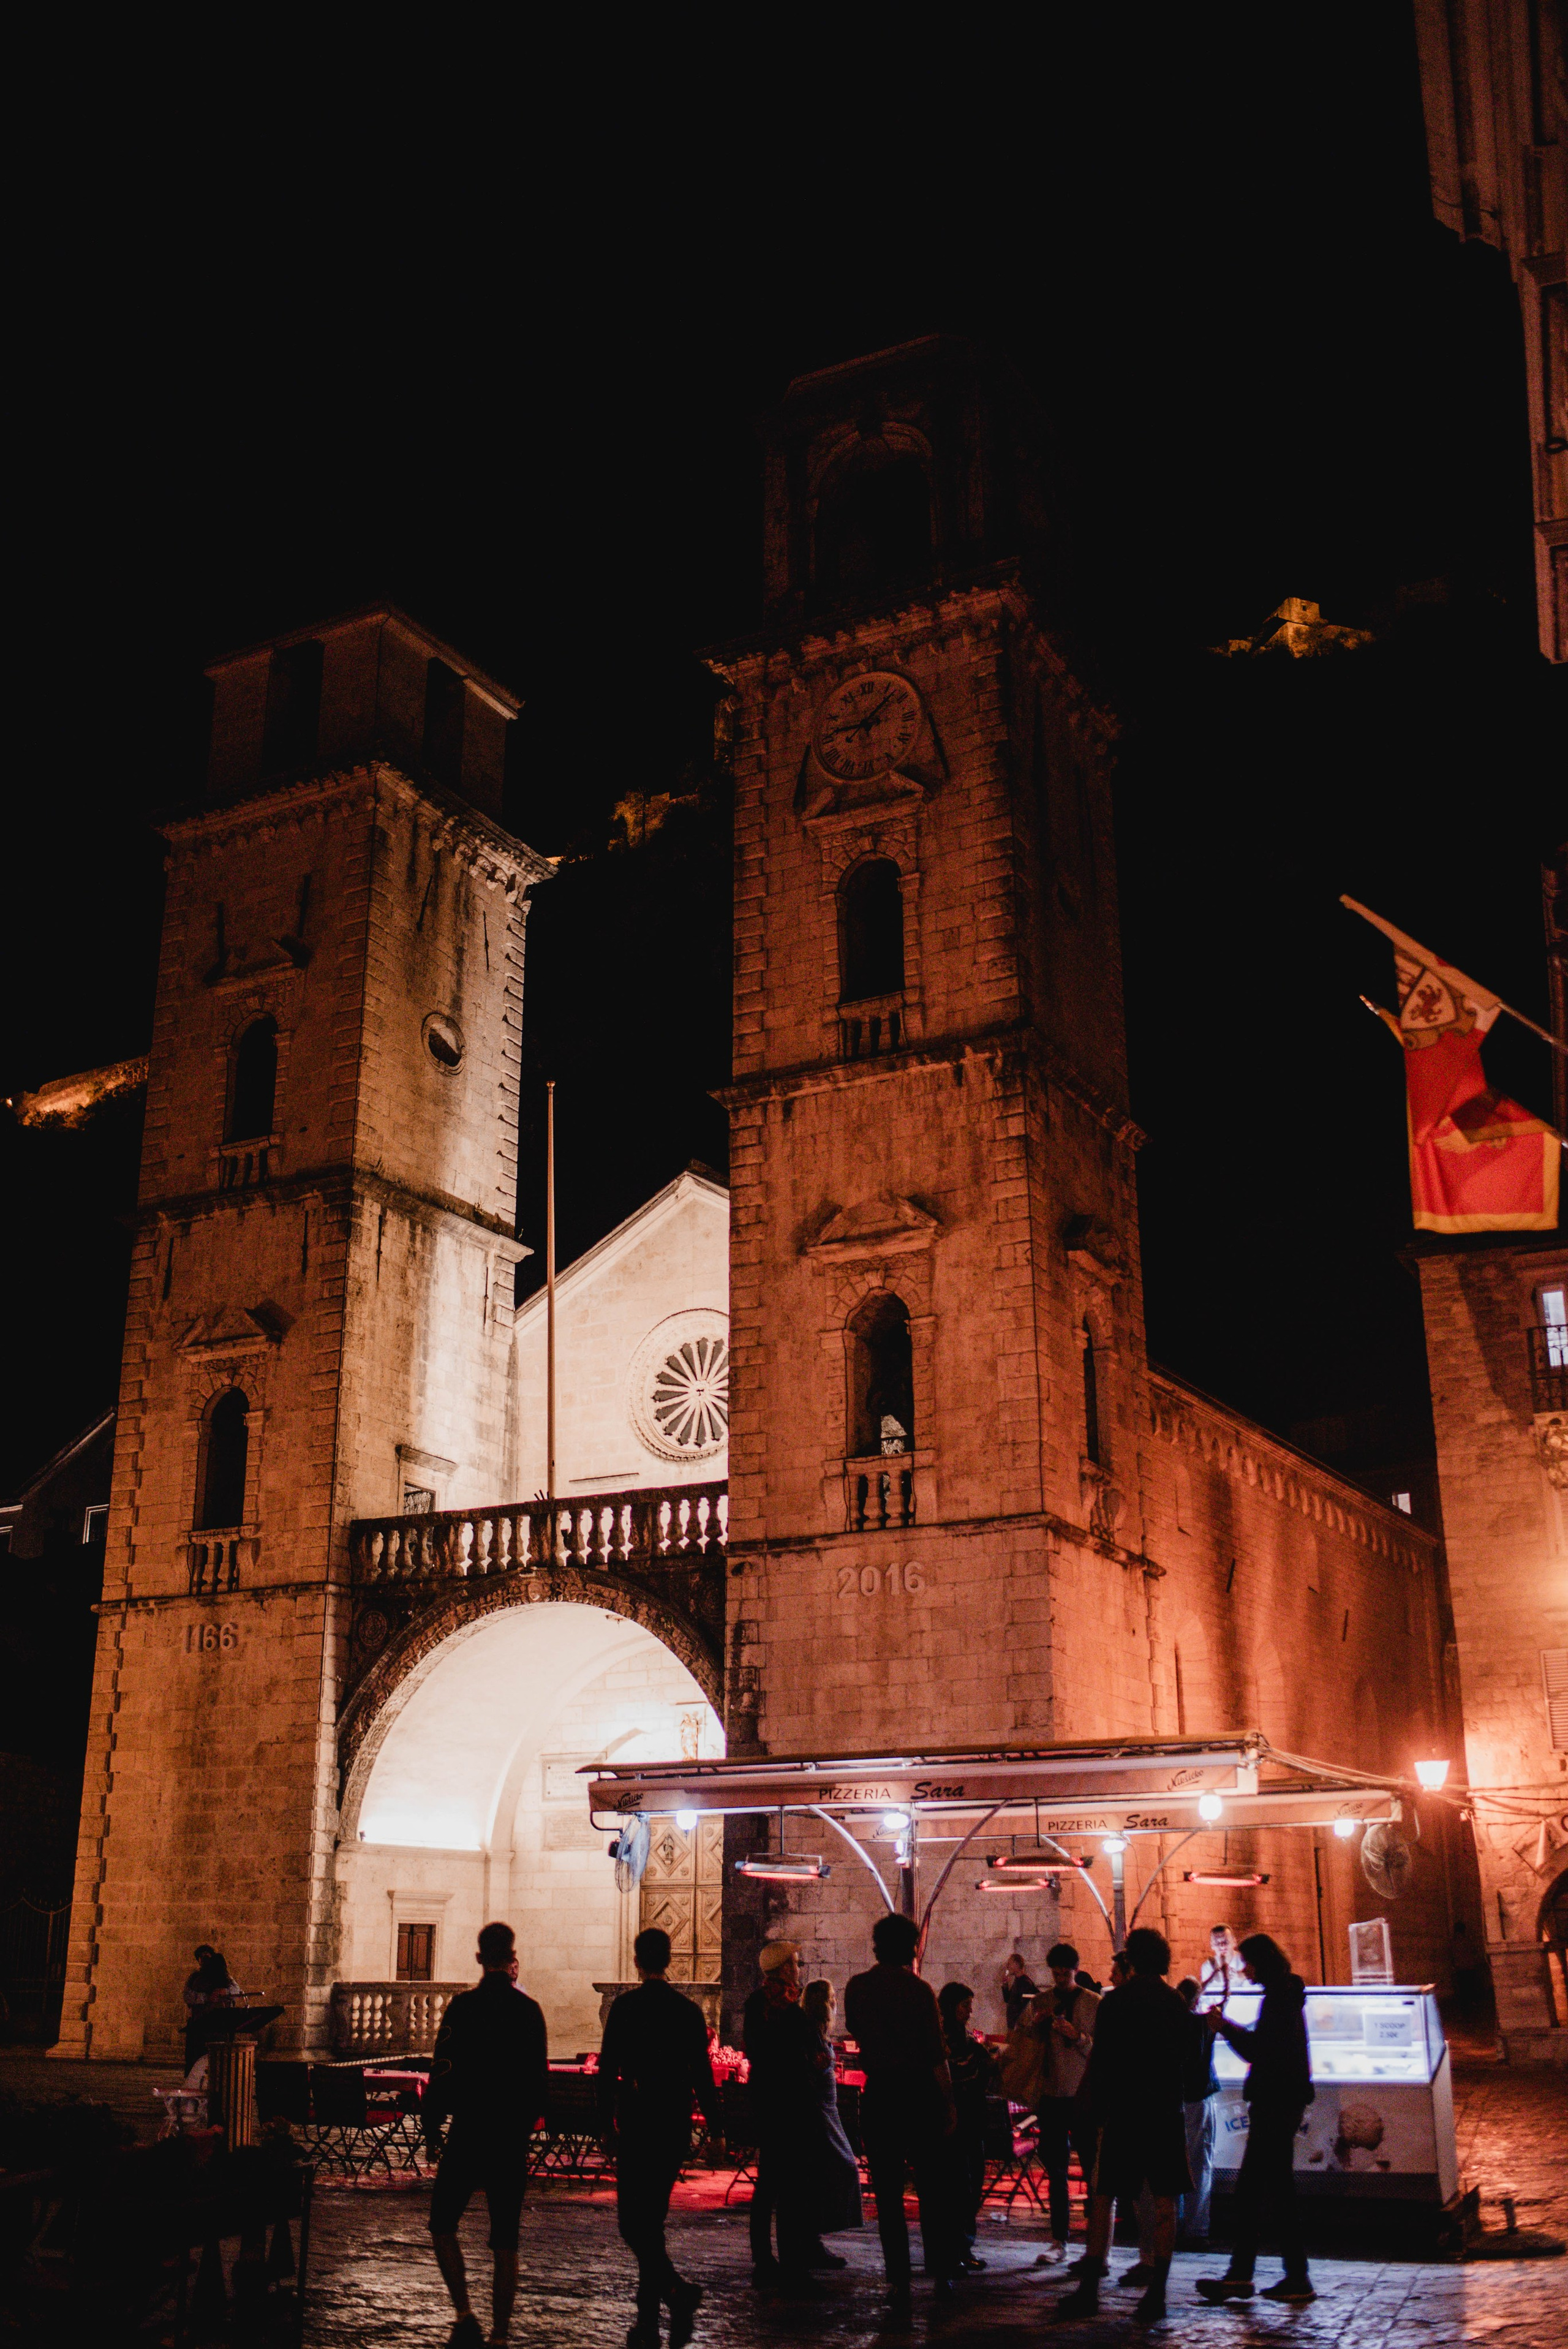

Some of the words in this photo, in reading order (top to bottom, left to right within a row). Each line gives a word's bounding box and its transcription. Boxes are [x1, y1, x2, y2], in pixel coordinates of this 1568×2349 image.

[837, 1561, 926, 1599] 2016
[184, 1622, 239, 1654] 1166
[819, 1787, 891, 1800] PIZZERIA
[910, 1781, 964, 1800] Sara
[1048, 1820, 1107, 1831] PIZZERIA
[1123, 1814, 1168, 1829] Sara
[1224, 2116, 1250, 2132] ICE
